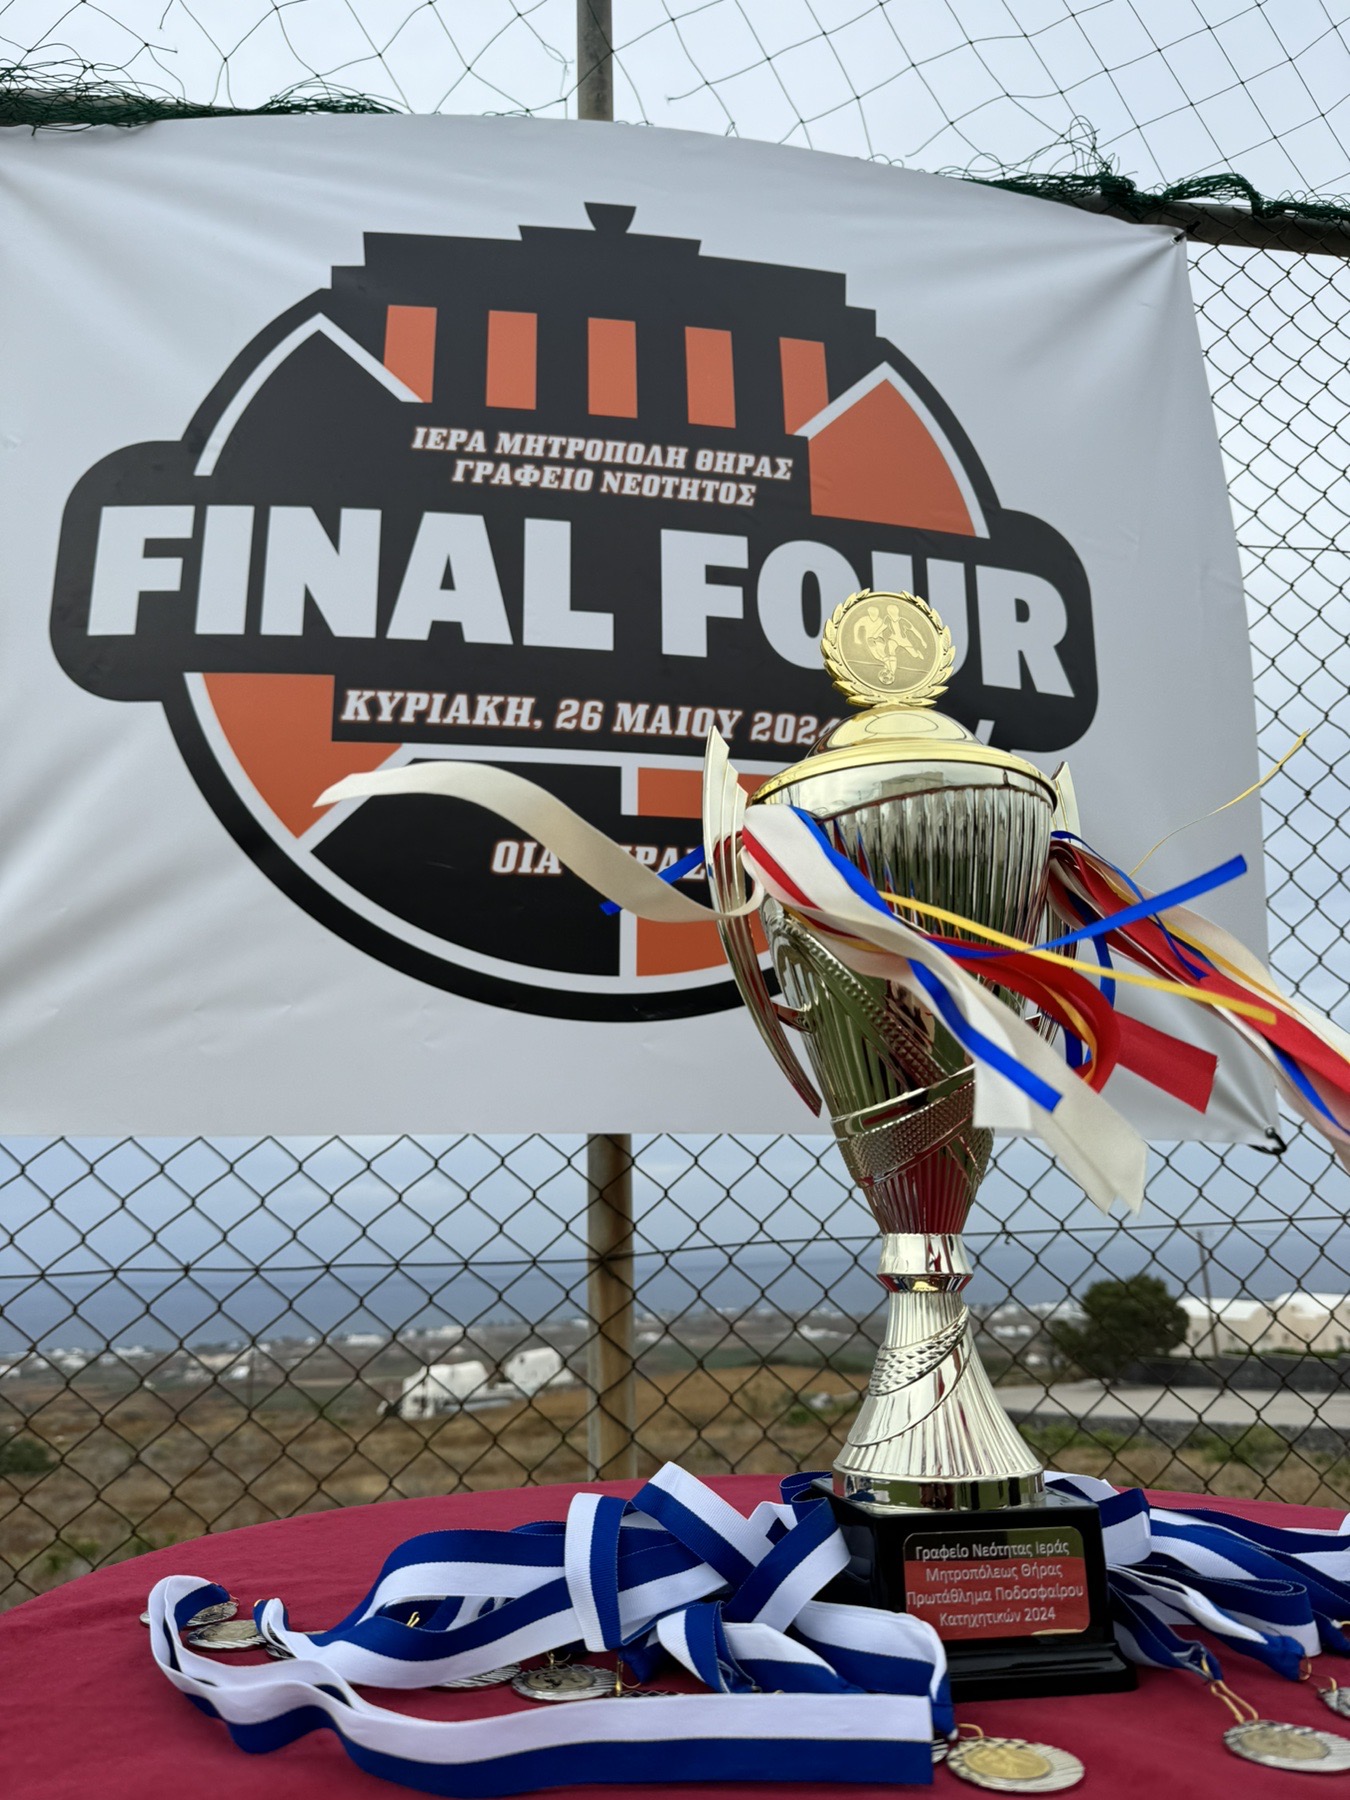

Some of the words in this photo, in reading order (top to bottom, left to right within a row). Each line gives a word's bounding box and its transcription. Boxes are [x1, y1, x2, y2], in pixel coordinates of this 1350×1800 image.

[411, 426, 487, 453] ΙΕΡΑ
[495, 431, 689, 470] ΜΗΤΡΟΠΟΛΗ
[694, 449, 794, 481] ΘΗΡΑΣ
[452, 459, 594, 492] ΓΡΑΦΕΙΟ
[600, 470, 757, 507] ΝΕΟΤΗΤΟΣ
[87, 505, 614, 651] FINAL
[341, 689, 542, 730] ΚΥΡΙΑΚΗ,
[555, 699, 602, 731] 26
[612, 703, 742, 739] ΜΑΙΟΥ
[491, 841, 562, 875] ΟΙΑ
[915, 1543, 969, 1562] Γραφείο
[972, 1542, 1033, 1558] Νεότητας
[1036, 1539, 1070, 1557] Ιεράς
[926, 1564, 1019, 1584] Μητροπόλεως
[1021, 1562, 1063, 1579] Θήρας
[906, 1588, 992, 1608] Πρωτάθλημα
[995, 1584, 1084, 1601] Ποδοσφαίρου
[940, 1608, 1021, 1628] Κατηχητικών
[1024, 1607, 1056, 1622] 2024
